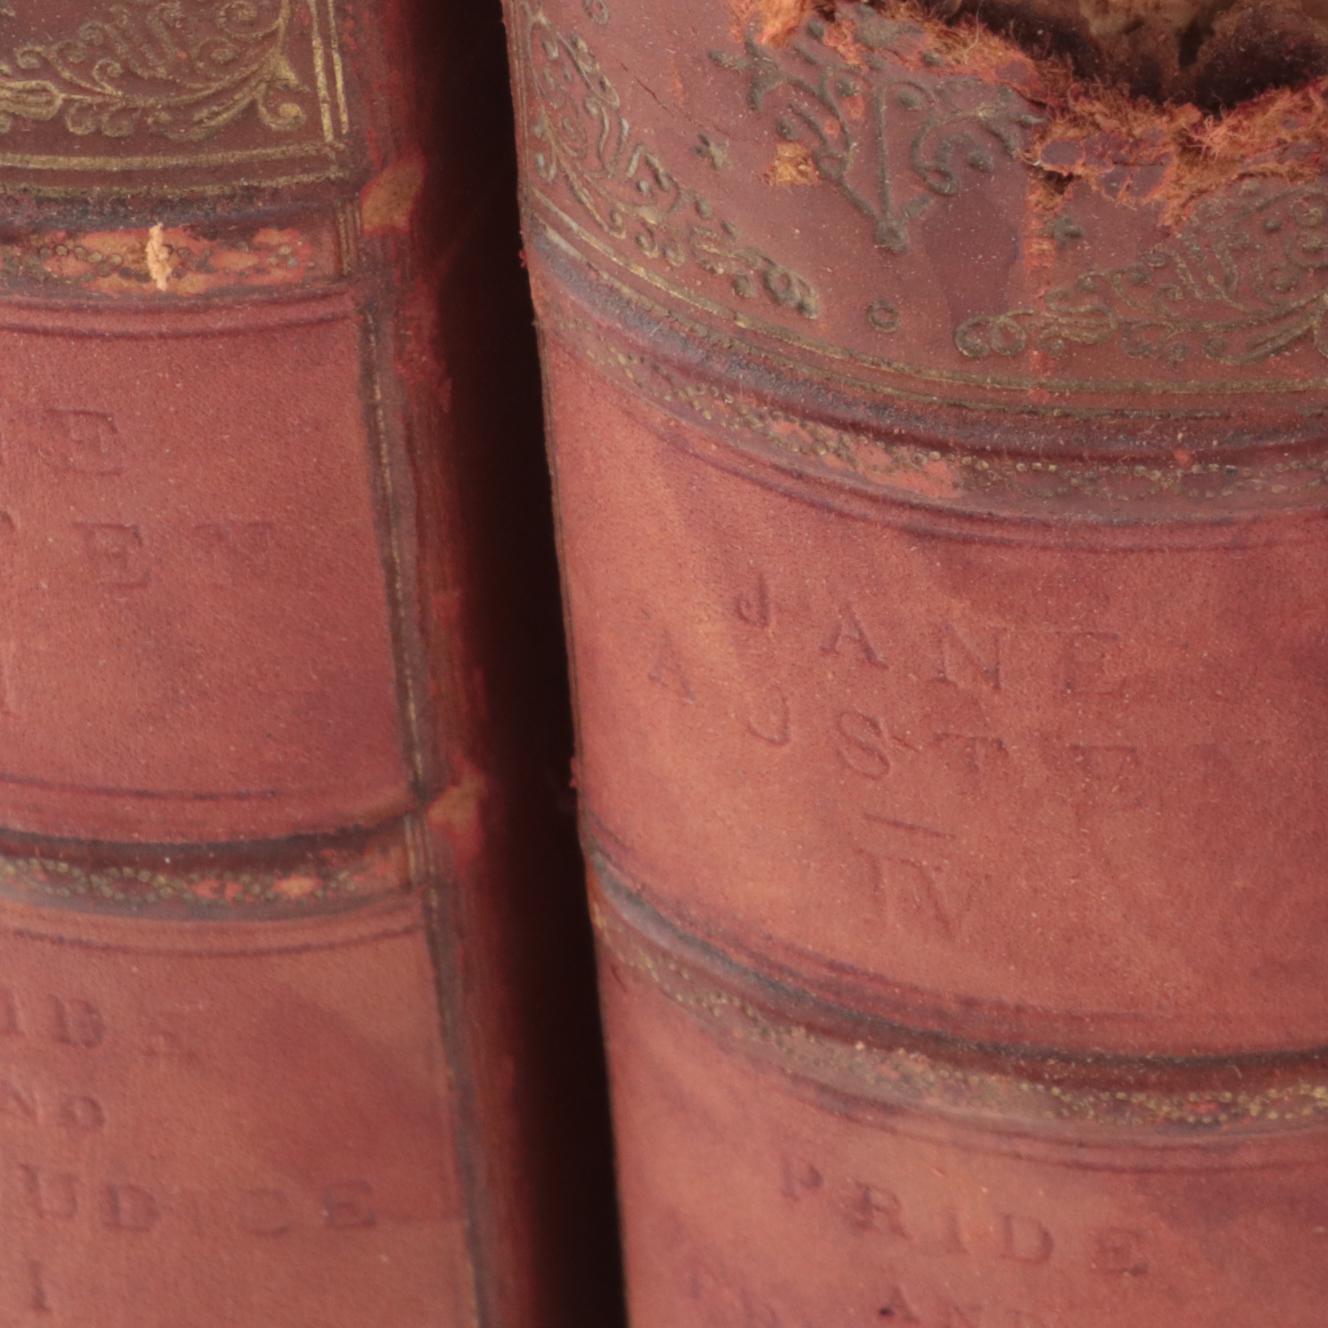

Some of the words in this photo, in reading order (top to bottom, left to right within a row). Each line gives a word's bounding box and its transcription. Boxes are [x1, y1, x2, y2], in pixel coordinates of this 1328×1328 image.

[734, 569, 1126, 698] JANE
[646, 621, 1268, 809] AUSTE
[779, 1154, 1150, 1278] PRIDE
